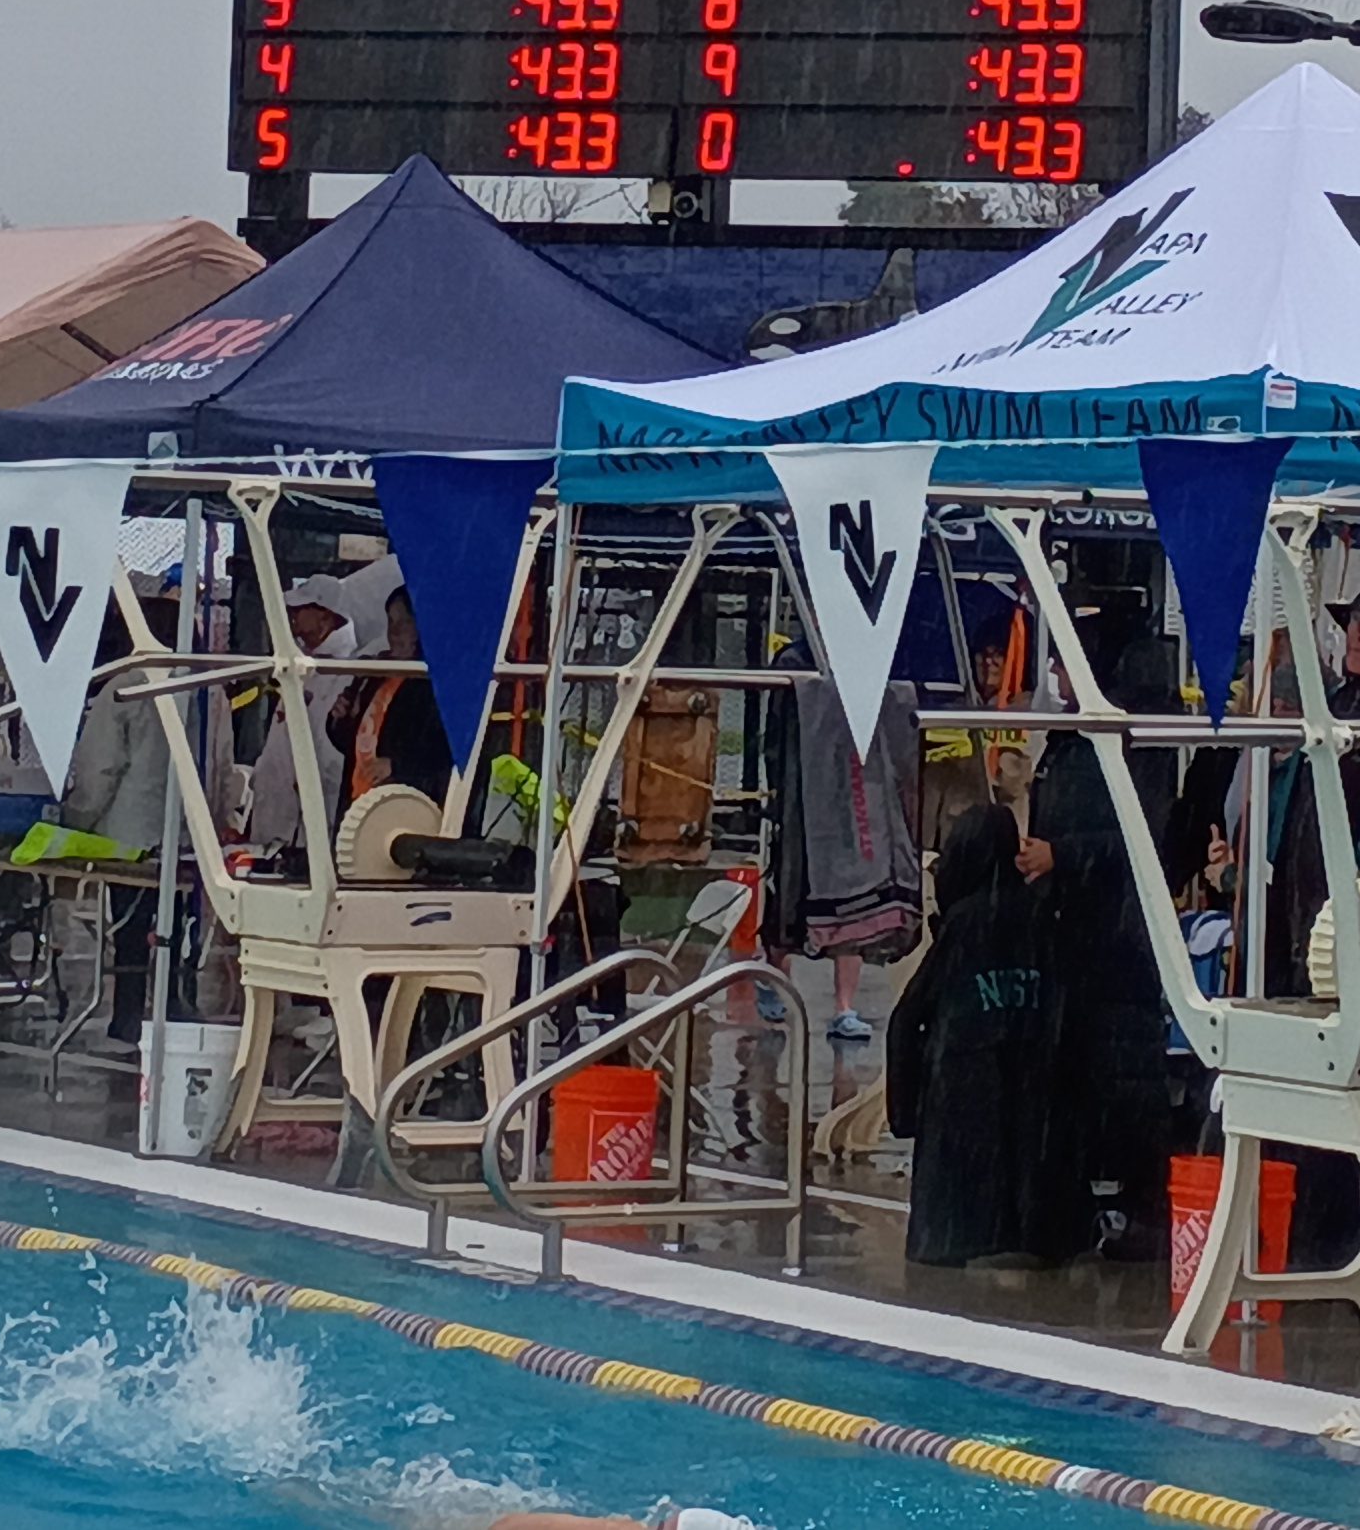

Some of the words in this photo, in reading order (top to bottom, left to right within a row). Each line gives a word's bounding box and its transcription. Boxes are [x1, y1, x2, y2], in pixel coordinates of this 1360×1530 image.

[259, 43, 293, 94] 4
[703, 42, 738, 98] 9
[257, 107, 288, 170] 5
[698, 111, 735, 172] 0
[916, 387, 1044, 442] SWIM
[1069, 393, 1205, 444] TEAM
